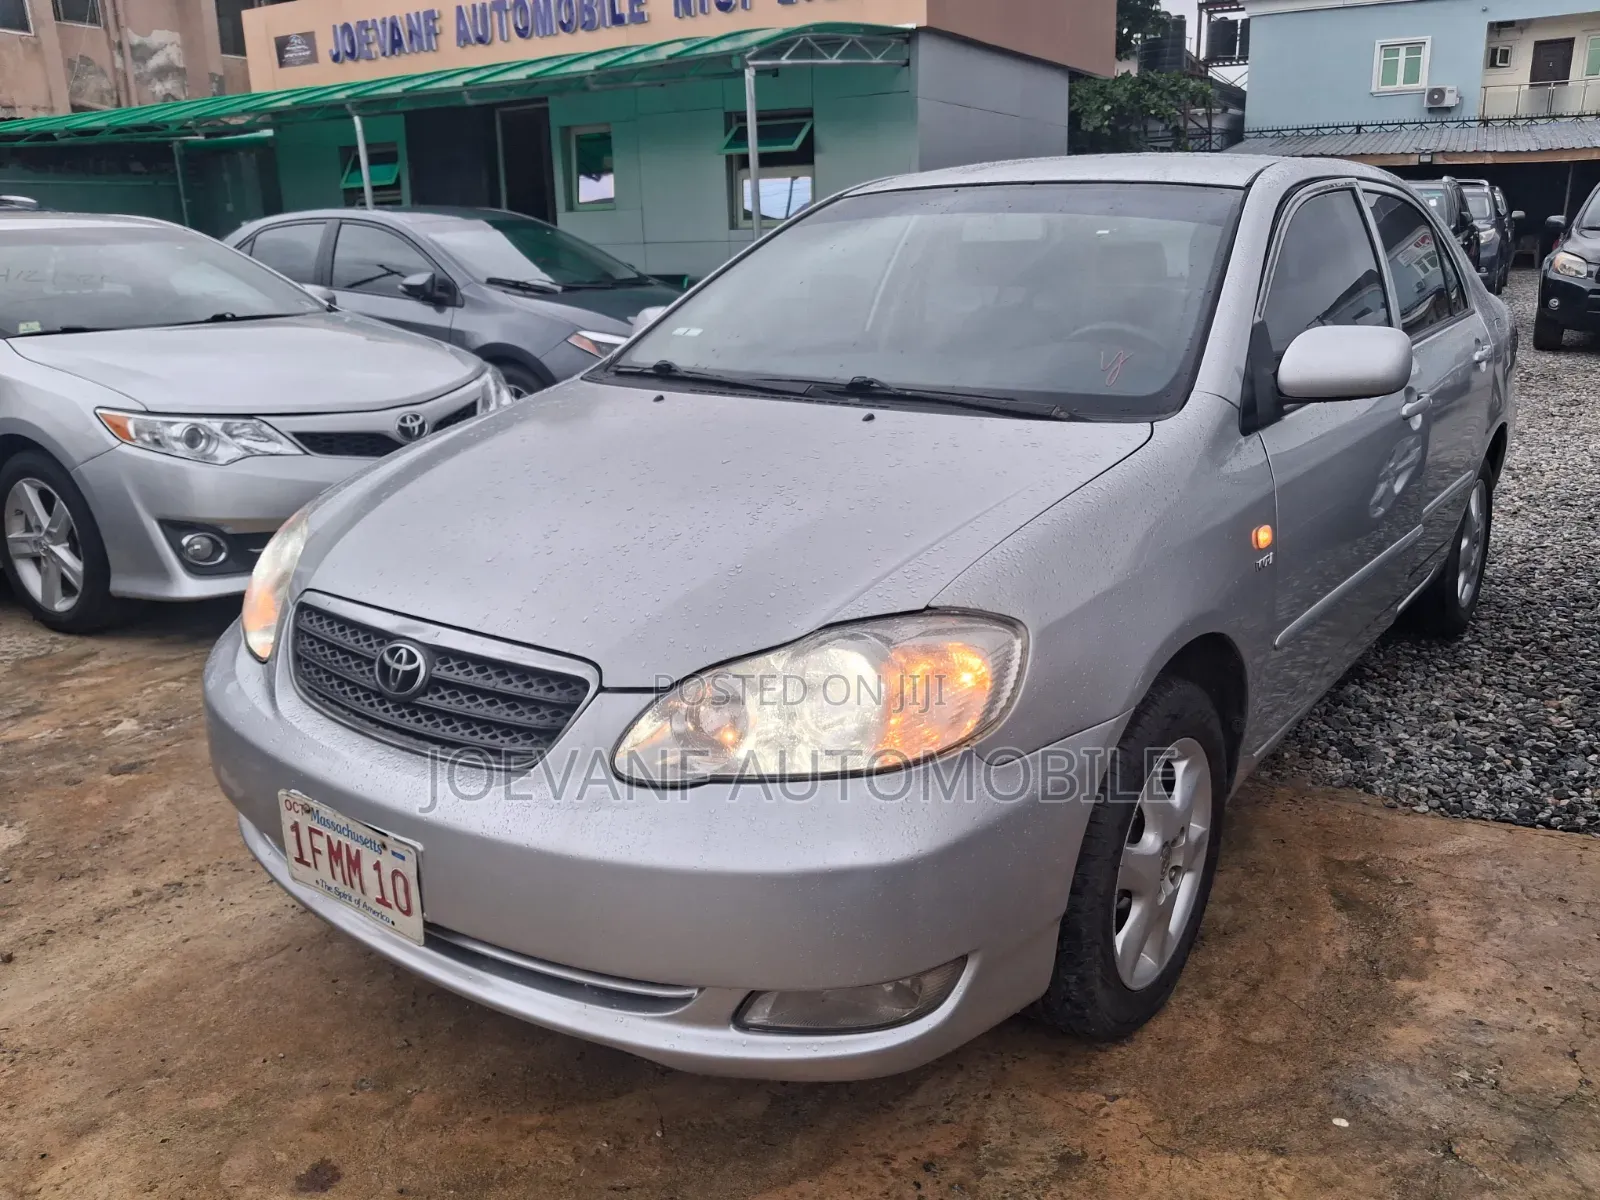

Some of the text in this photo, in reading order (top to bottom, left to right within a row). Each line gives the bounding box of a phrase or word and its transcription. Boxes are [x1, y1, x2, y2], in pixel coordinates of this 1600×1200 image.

[329, 0, 649, 64] JOEVANF AUTOMOBILE
[284, 799, 383, 855] OCT Massachusetts
[290, 821, 413, 917] 1FMM 10
[320, 878, 391, 924] The Spirit of America
